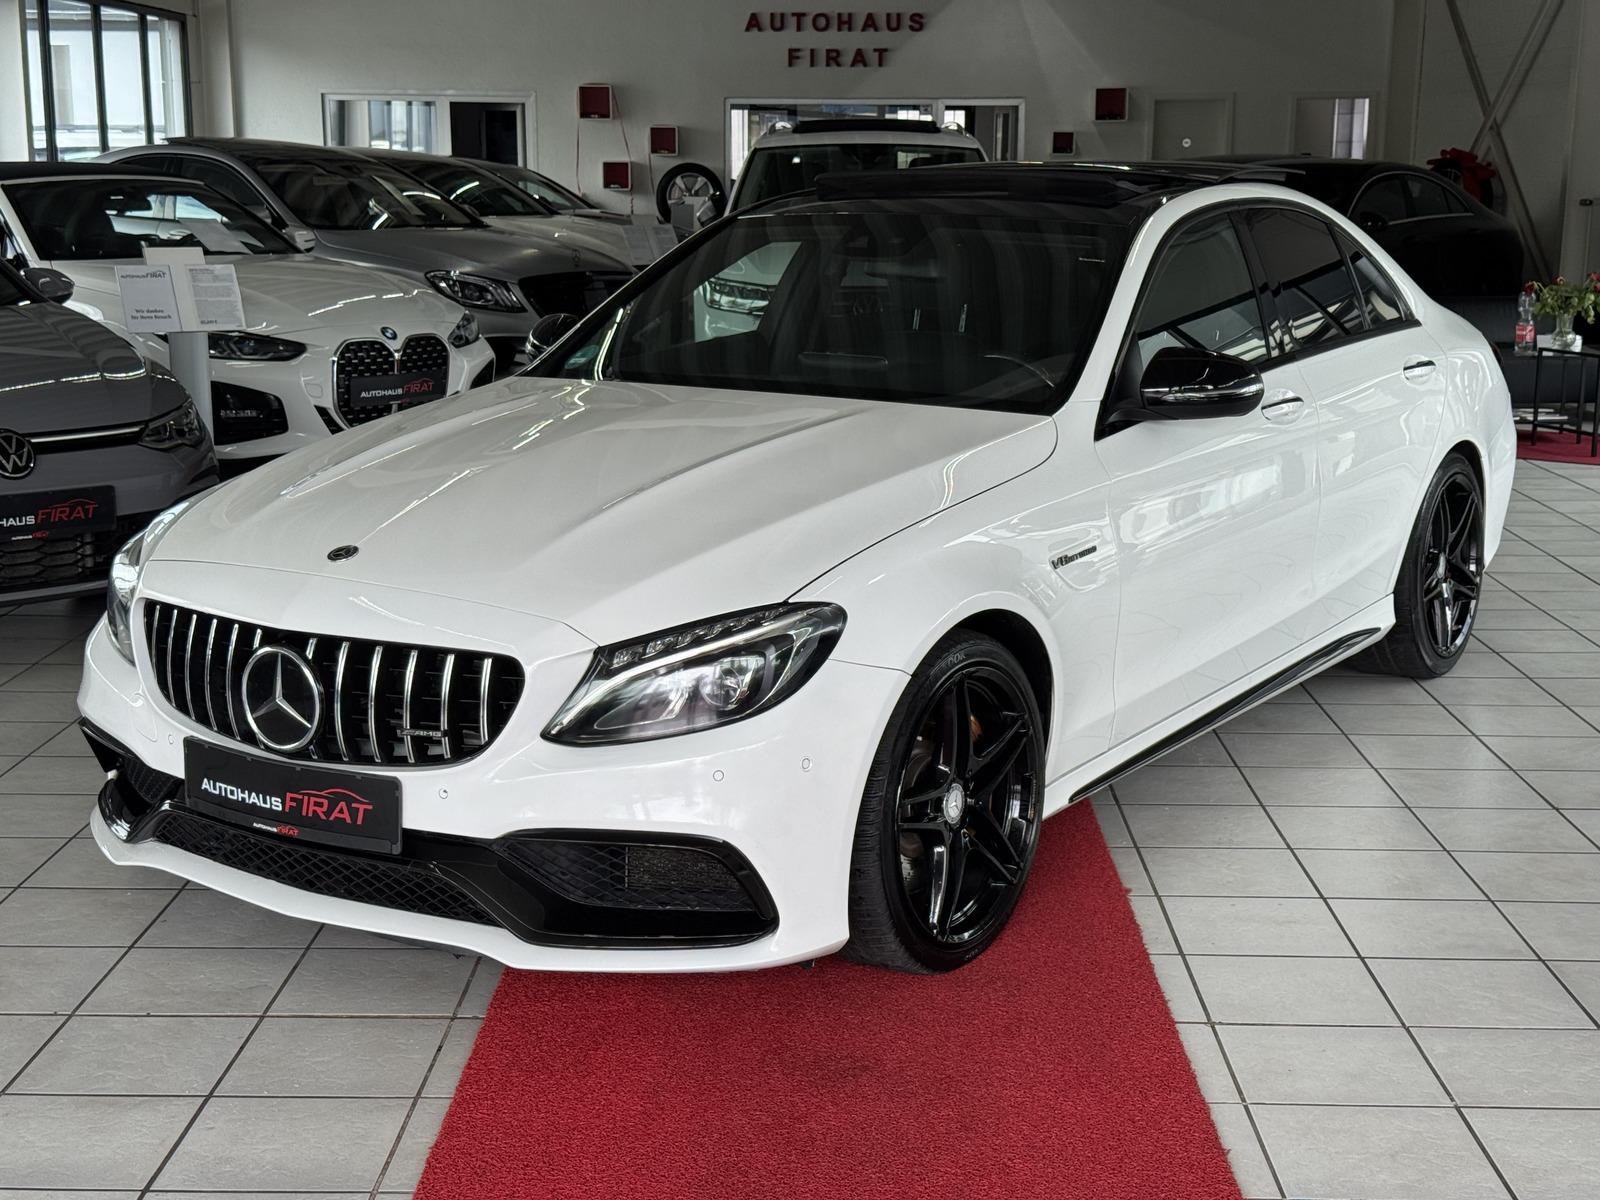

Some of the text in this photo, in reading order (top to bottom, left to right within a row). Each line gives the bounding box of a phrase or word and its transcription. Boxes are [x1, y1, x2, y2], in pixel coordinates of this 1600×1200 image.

[745, 12, 925, 33] AUTOHAUS
[787, 47, 889, 68] FIRAT
[360, 382, 433, 398] AUTOHAUS FIRAT
[37, 504, 98, 523] FIRAT
[201, 777, 373, 825] AUTOHAUS FIRAT
